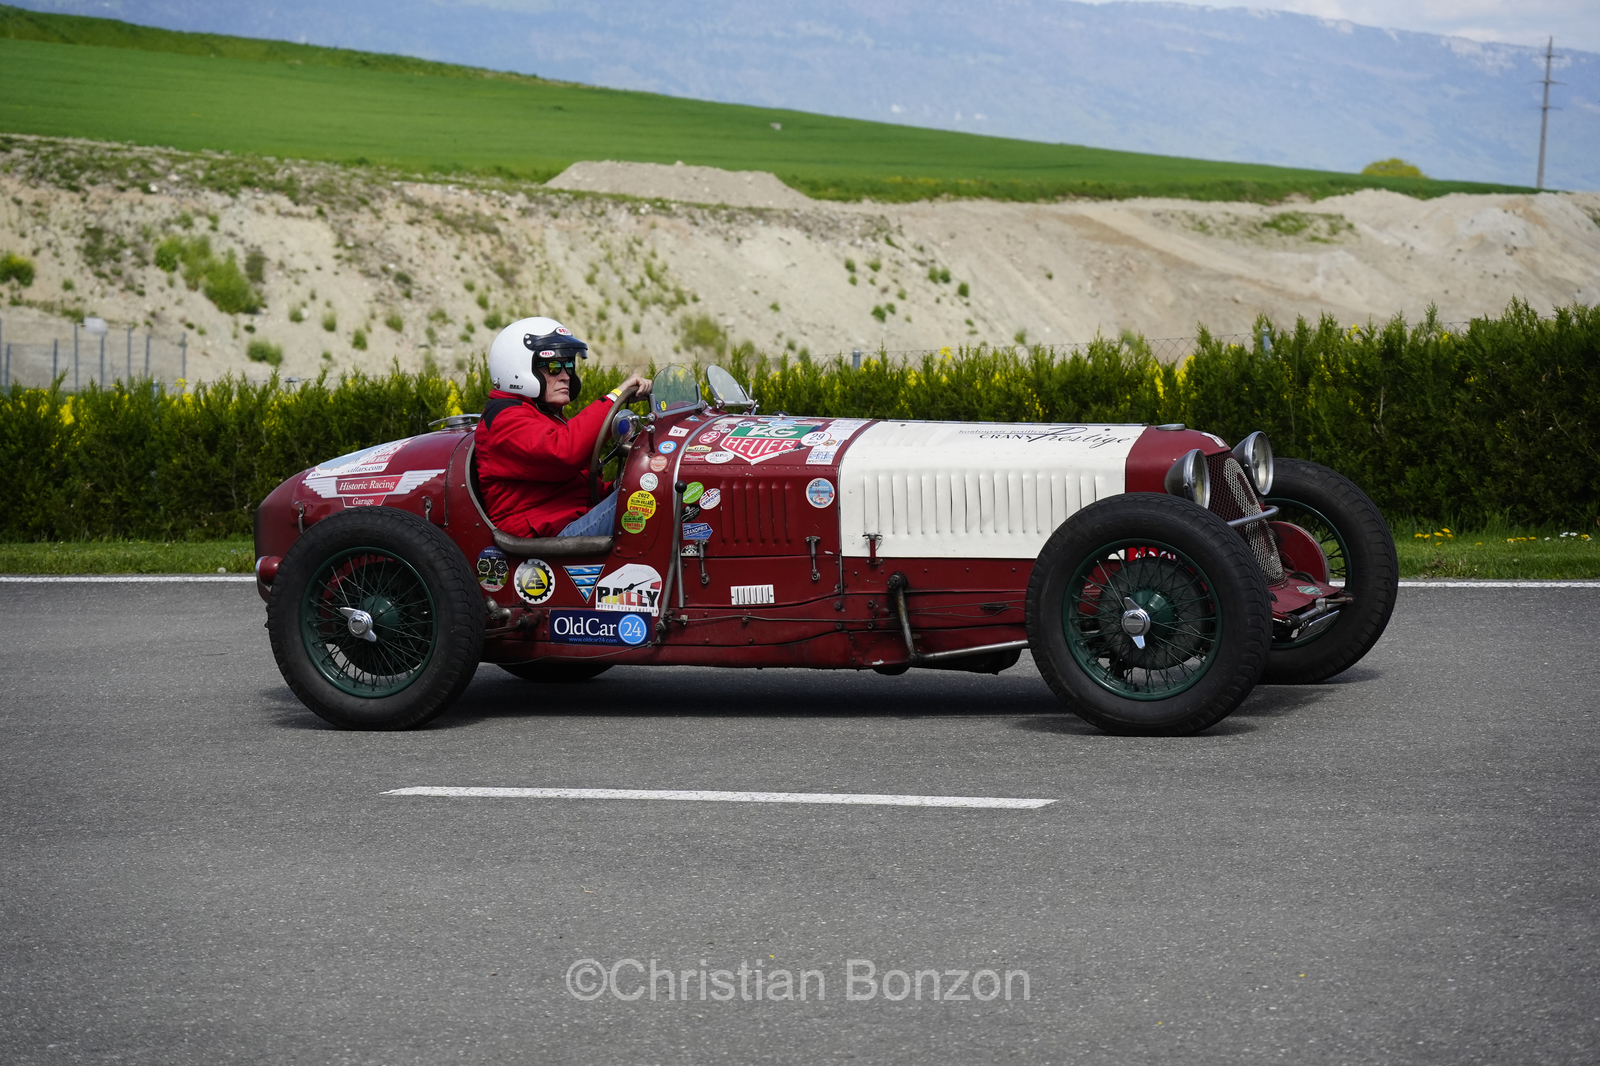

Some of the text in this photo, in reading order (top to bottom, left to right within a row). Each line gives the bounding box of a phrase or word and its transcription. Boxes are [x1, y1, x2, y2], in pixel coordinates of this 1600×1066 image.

[748, 425, 800, 438] TAG
[809, 432, 826, 441] 29
[725, 438, 796, 456] HEUER
[339, 480, 396, 491] Historic Racing
[352, 497, 375, 506] Garage
[596, 586, 660, 608] RALLY
[553, 616, 642, 637] OldCar 24
[568, 636, 618, 644] www.oldcar24.com
